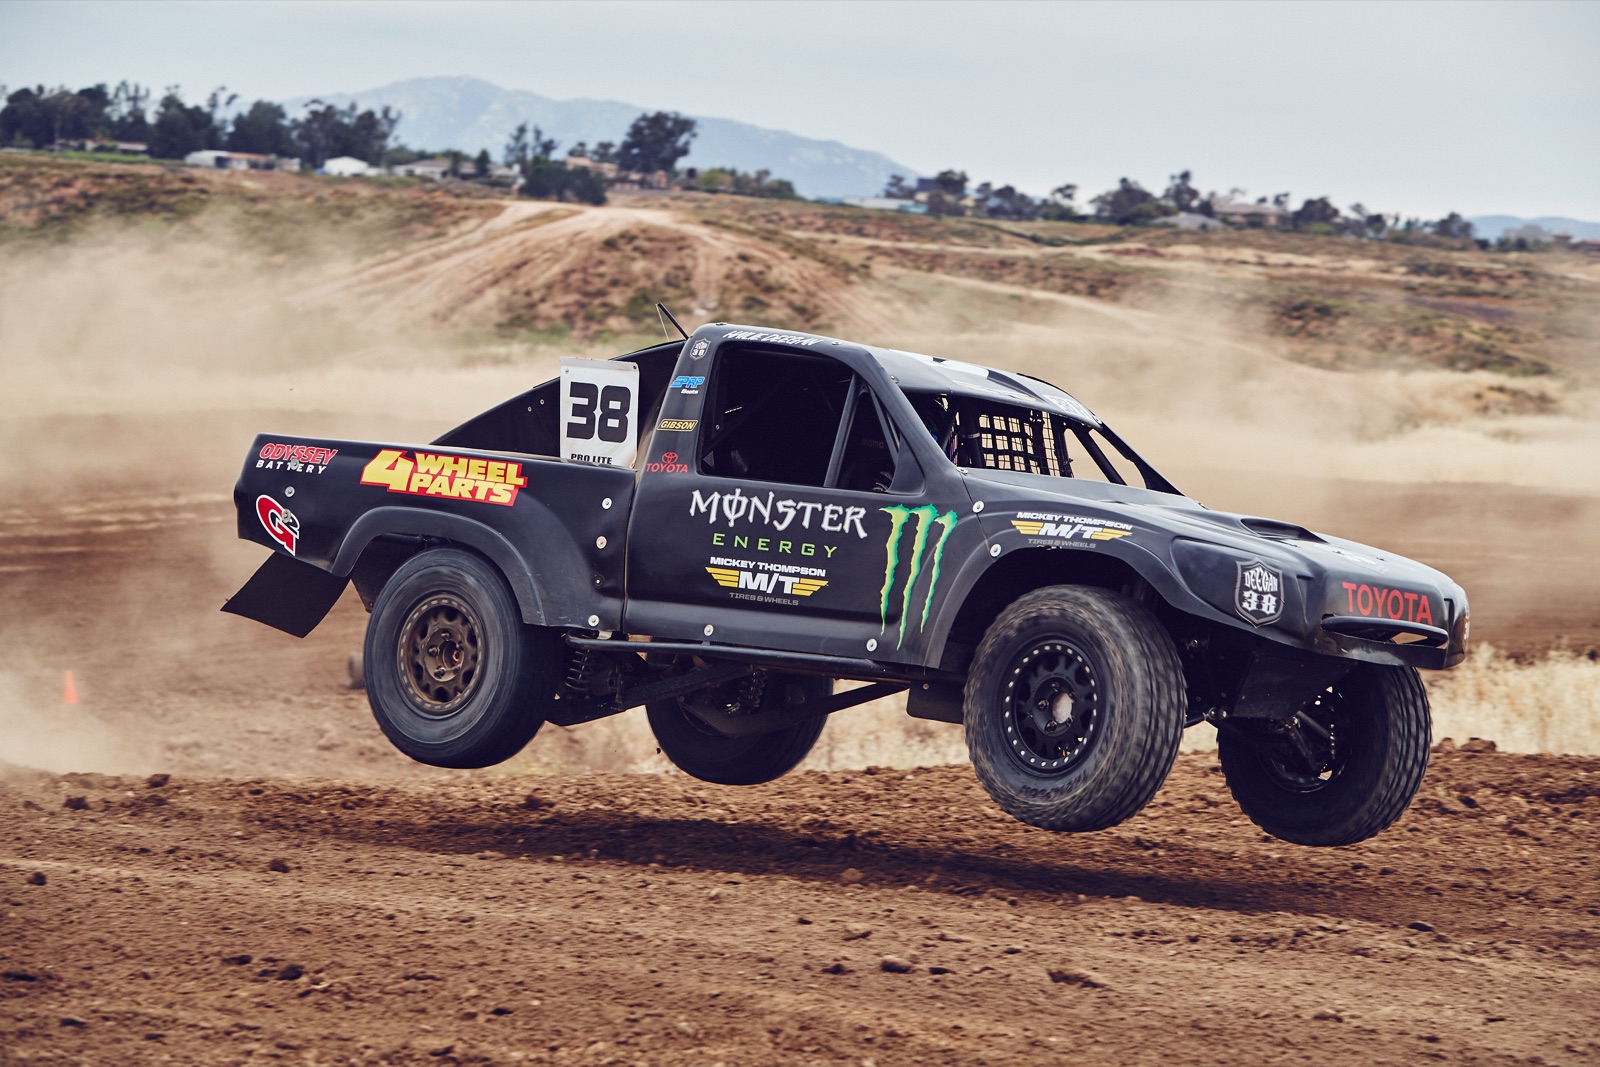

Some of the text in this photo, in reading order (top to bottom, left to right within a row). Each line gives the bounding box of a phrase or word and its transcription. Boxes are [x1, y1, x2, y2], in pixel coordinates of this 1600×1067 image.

[671, 376, 705, 388] PRP
[566, 381, 631, 443] 38
[660, 420, 695, 430] GIBSON
[259, 443, 338, 465] ODYSSEY
[570, 453, 612, 465] PRO LITE
[256, 460, 327, 475] BATTERY
[361, 450, 525, 492] 4 WHEEL
[646, 463, 688, 473] TOYOTA
[409, 473, 515, 504] PARTS
[689, 488, 868, 539] MONSTER
[1016, 511, 1133, 530] MICKEY THOMPSON
[1039, 522, 1104, 539] M/T
[712, 532, 838, 558] ENERGY
[1028, 539, 1055, 547] TIRES
[1061, 540, 1096, 549] WHEELS
[710, 556, 826, 577] MICKEY THOMPSON
[738, 571, 800, 594] M/T
[1242, 566, 1279, 592] DEEGAN
[729, 592, 756, 602] TIRES
[764, 596, 799, 606] WHEELS
[1241, 590, 1277, 616] 38
[1342, 581, 1433, 626] TOYOTA
